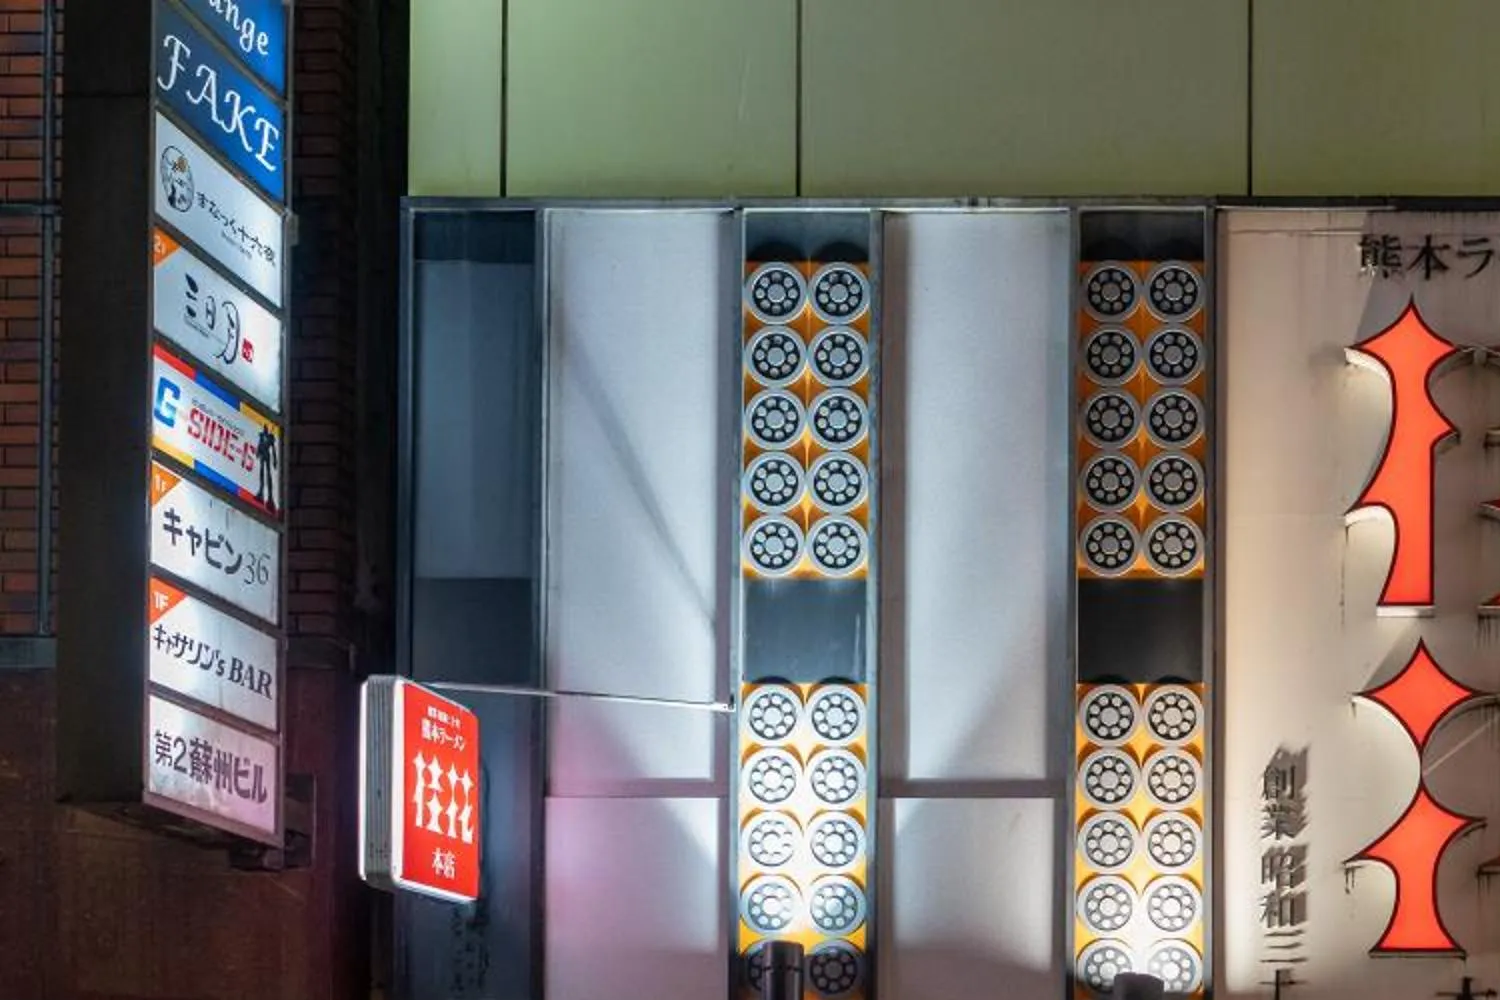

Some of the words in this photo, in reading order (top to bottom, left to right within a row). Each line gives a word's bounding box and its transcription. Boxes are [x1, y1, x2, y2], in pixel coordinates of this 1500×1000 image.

[157, 34, 280, 173] FAKE
[155, 376, 180, 428] G
[228, 657, 273, 699] BAR
[154, 731, 267, 803] 第2蘇州ビル
[432, 848, 455, 880] 本店
